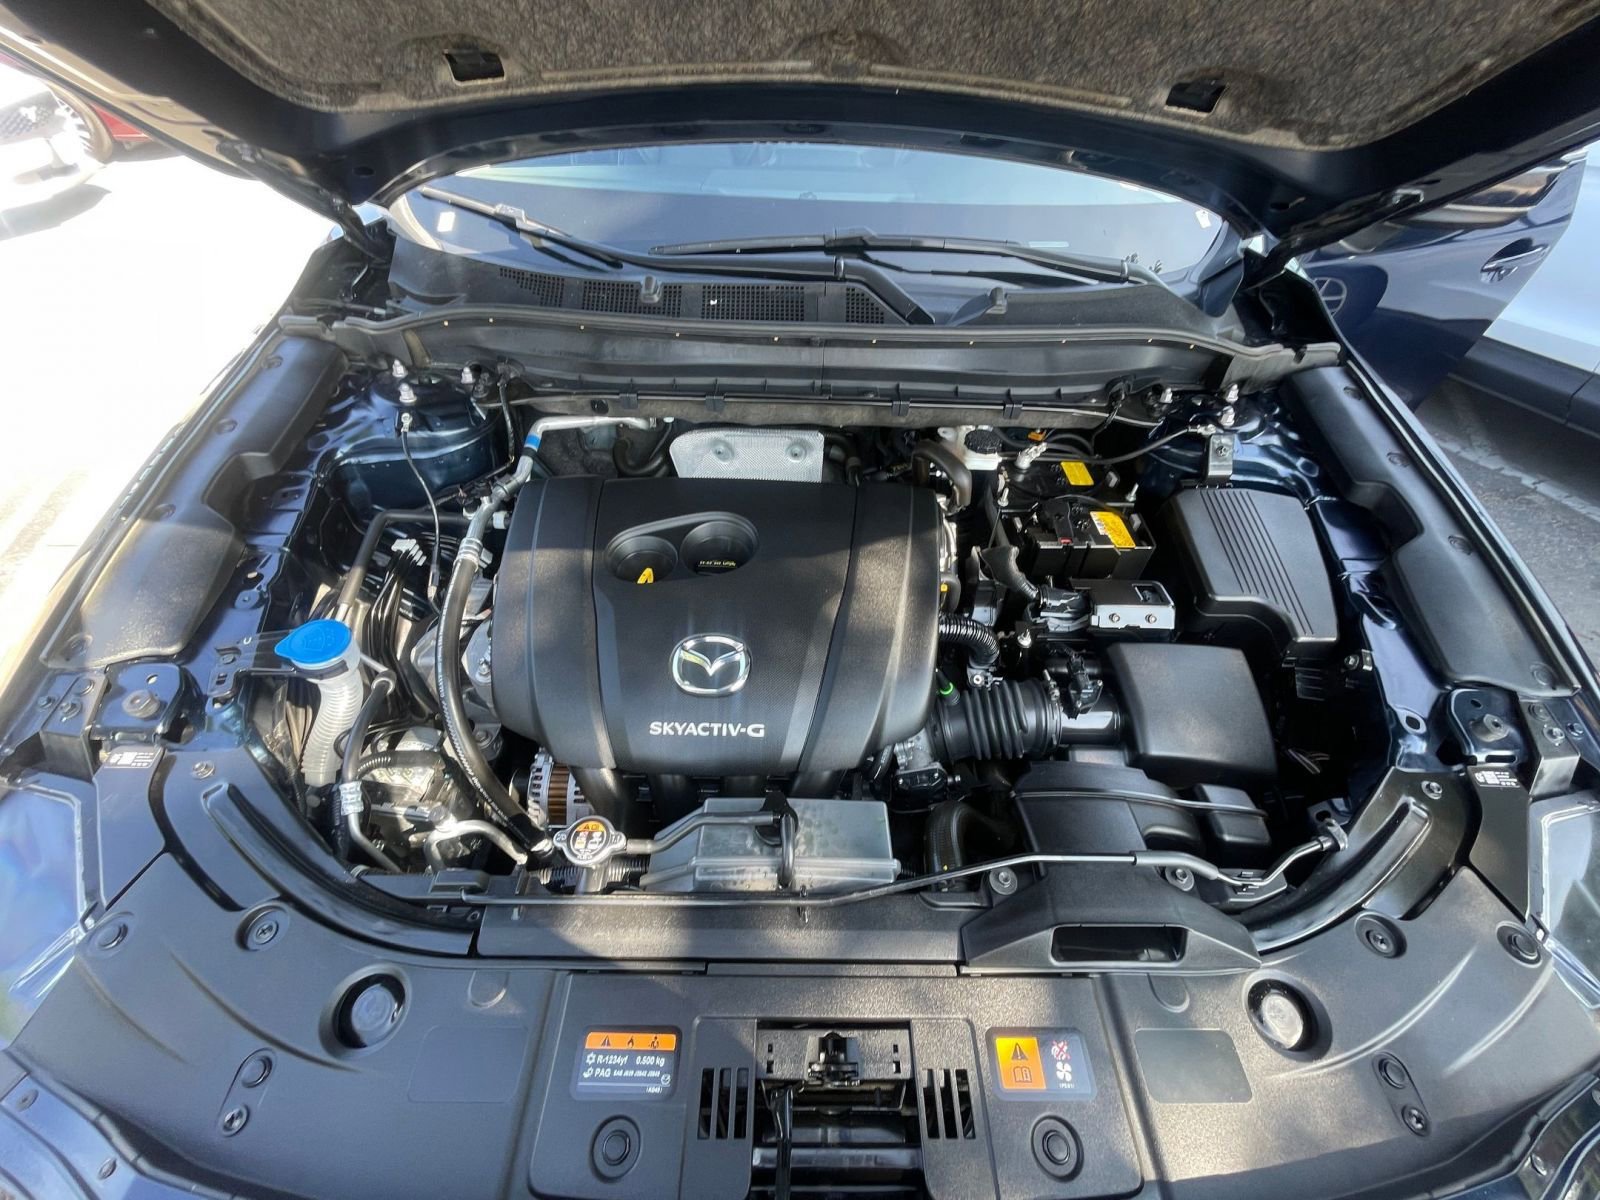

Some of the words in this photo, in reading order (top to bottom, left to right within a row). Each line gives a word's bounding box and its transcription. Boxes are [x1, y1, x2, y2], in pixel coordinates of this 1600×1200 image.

[649, 721, 765, 738] SKYACTIV-G
[596, 1055, 629, 1066] R-1234yf
[655, 1056, 665, 1067] kg
[594, 1068, 612, 1078] PAG
